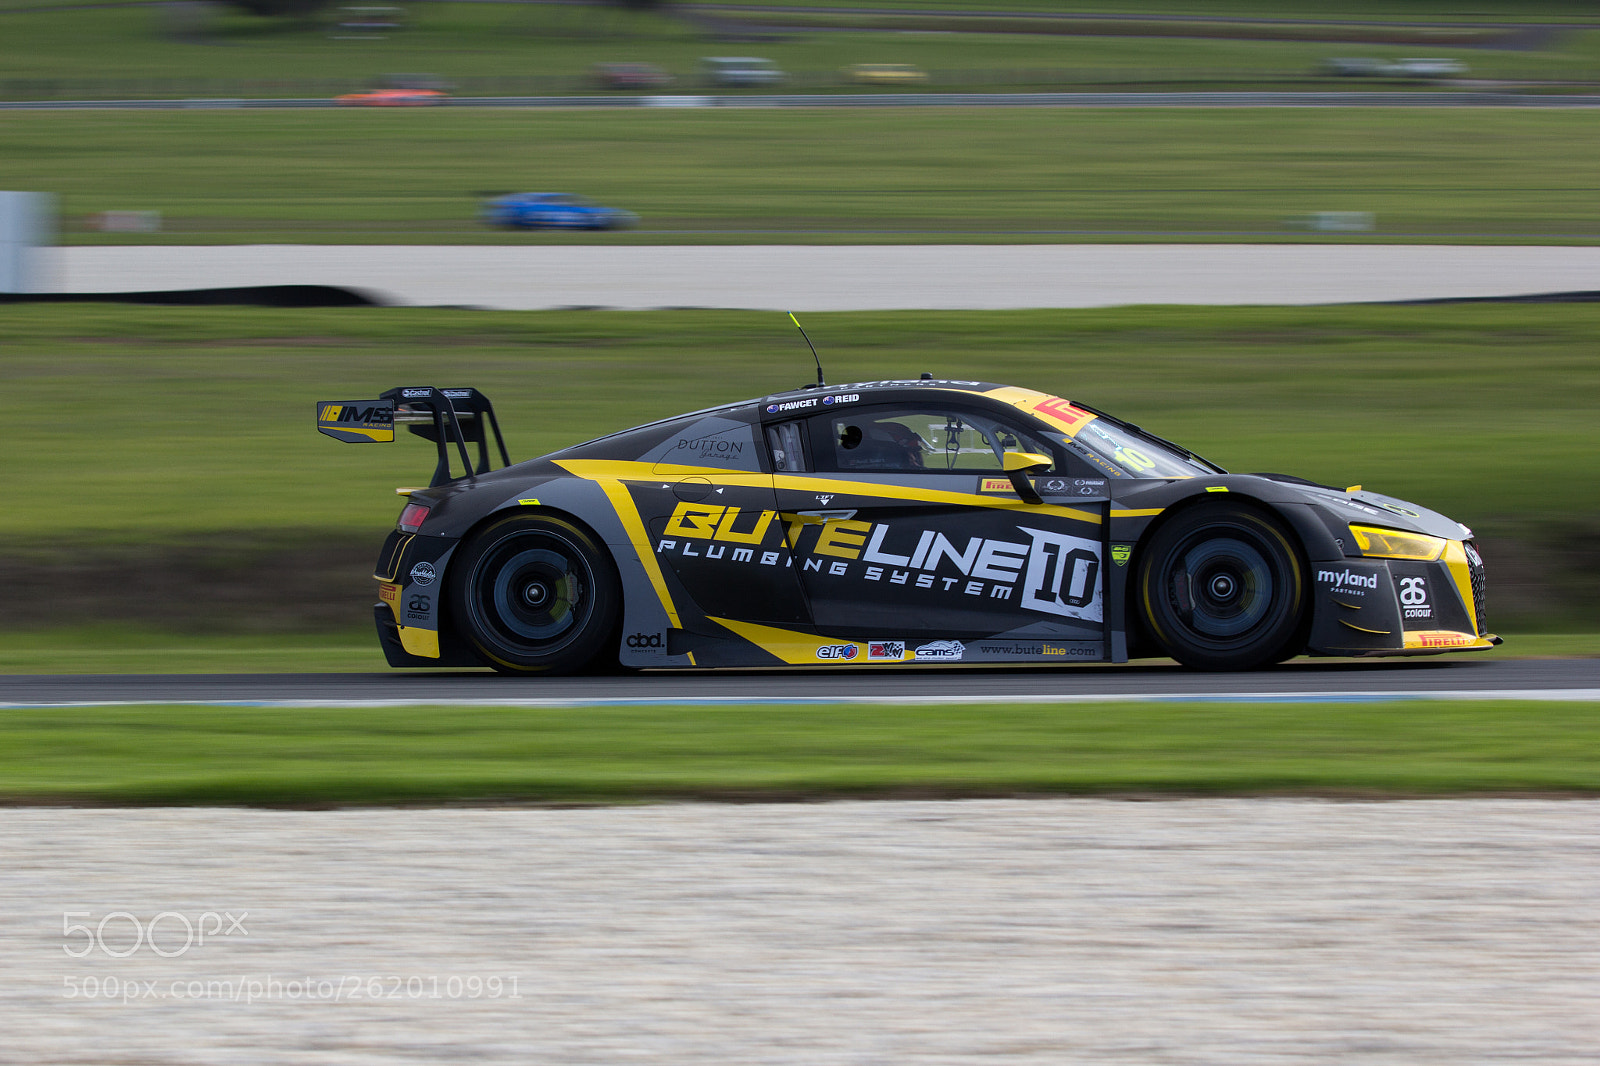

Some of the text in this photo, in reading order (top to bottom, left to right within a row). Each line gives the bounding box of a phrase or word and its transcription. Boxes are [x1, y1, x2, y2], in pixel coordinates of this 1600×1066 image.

[779, 398, 818, 412] FAWCET
[834, 393, 860, 404] REID
[336, 405, 393, 424] IMS
[678, 439, 743, 453] DUTTON
[1087, 453, 1121, 477] RACING
[1113, 447, 1156, 472] 10
[663, 501, 1030, 583] BUTELINE
[657, 539, 1014, 600] PLUMBING SYSTEM
[1034, 541, 1099, 608] 10
[1317, 569, 1378, 589] myland
[1330, 587, 1365, 596] PARTNERS
[407, 613, 430, 621] colour
[1405, 609, 1432, 618] colour
[1418, 634, 1465, 647] PIRELLI
[818, 645, 843, 659] elf
[915, 648, 955, 657] cams
[980, 644, 1096, 656] www.buteline.com
